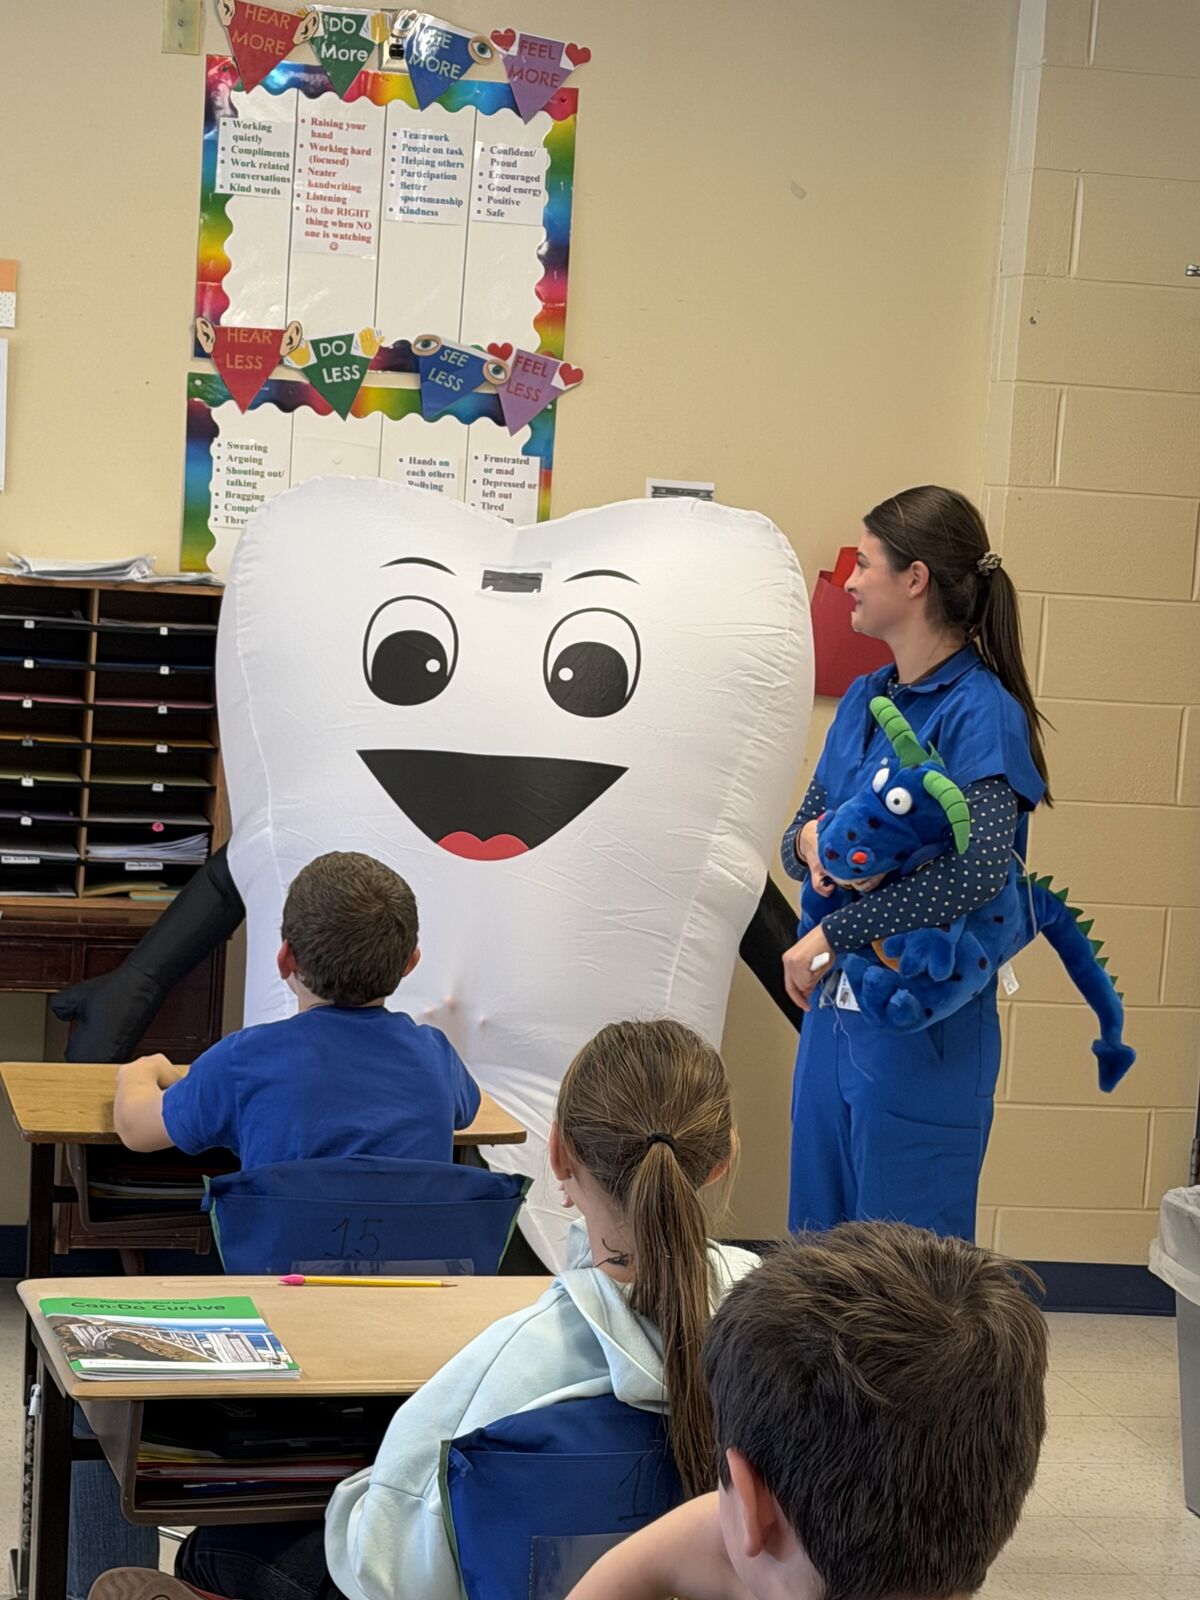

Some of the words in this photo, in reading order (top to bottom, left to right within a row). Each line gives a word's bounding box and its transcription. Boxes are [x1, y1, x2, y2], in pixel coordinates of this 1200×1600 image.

[245, 4, 290, 29] HEAR
[329, 16, 356, 34] DO
[232, 30, 287, 55] MORE
[321, 43, 368, 62] More
[518, 40, 556, 60] FEEL
[409, 55, 461, 80] MORE
[508, 64, 560, 88] MORE
[233, 120, 272, 133] Working
[311, 118, 343, 130] Raising
[345, 123, 367, 131] your
[233, 134, 262, 144] quietly
[311, 130, 333, 139] hand
[231, 146, 290, 158] Compliments
[309, 142, 348, 155] Working
[351, 146, 371, 156] hard
[402, 144, 431, 154] People
[446, 148, 464, 156] task
[490, 146, 536, 157] Confident/
[231, 158, 256, 169] Work
[259, 162, 289, 171] related
[309, 155, 349, 166] (focused)
[401, 156, 436, 168] Helping
[438, 160, 464, 168] others
[491, 158, 517, 168] Proud
[231, 172, 290, 183] conversations
[307, 168, 337, 177] Neater
[401, 169, 457, 181] Participation
[229, 183, 252, 192] Kind
[254, 186, 280, 195] words
[308, 180, 362, 193] handwriting
[400, 181, 427, 191] Better
[488, 184, 511, 193] Good
[513, 187, 541, 196] energy
[306, 192, 347, 204] Listening
[400, 194, 463, 207] sportsmanship
[487, 196, 520, 206] Positive
[306, 205, 318, 213] Do
[320, 206, 334, 215] the
[336, 209, 371, 218] RIGHT
[399, 206, 438, 216] Kindness
[486, 208, 505, 217] Safe
[306, 217, 328, 228] thing
[331, 220, 354, 228] when
[356, 221, 371, 230] NO
[323, 231, 330, 239] is
[332, 233, 371, 243] watching
[227, 328, 272, 344] HEAR
[319, 340, 346, 357] DO
[226, 353, 263, 370] LESS
[440, 349, 469, 367] SEE
[514, 356, 548, 378] FEEL
[322, 364, 360, 384] LESS
[428, 368, 464, 391] LESS
[506, 381, 542, 402] LESS
[227, 442, 268, 453] Swearing
[227, 454, 263, 465] Arguing
[409, 457, 436, 466] Hands
[484, 454, 529, 465] Frustrated
[226, 467, 265, 478] Shouting
[267, 470, 285, 478] out/
[428, 471, 455, 479] others
[226, 479, 257, 489] talking
[482, 478, 525, 489] Depressed
[225, 491, 265, 501] Bragging
[482, 490, 495, 498] left
[481, 502, 504, 511] Tired
[324, 1218, 383, 1258] 15
[71, 1302, 146, 1311] Can-Do
[152, 1303, 225, 1311] Cursive
